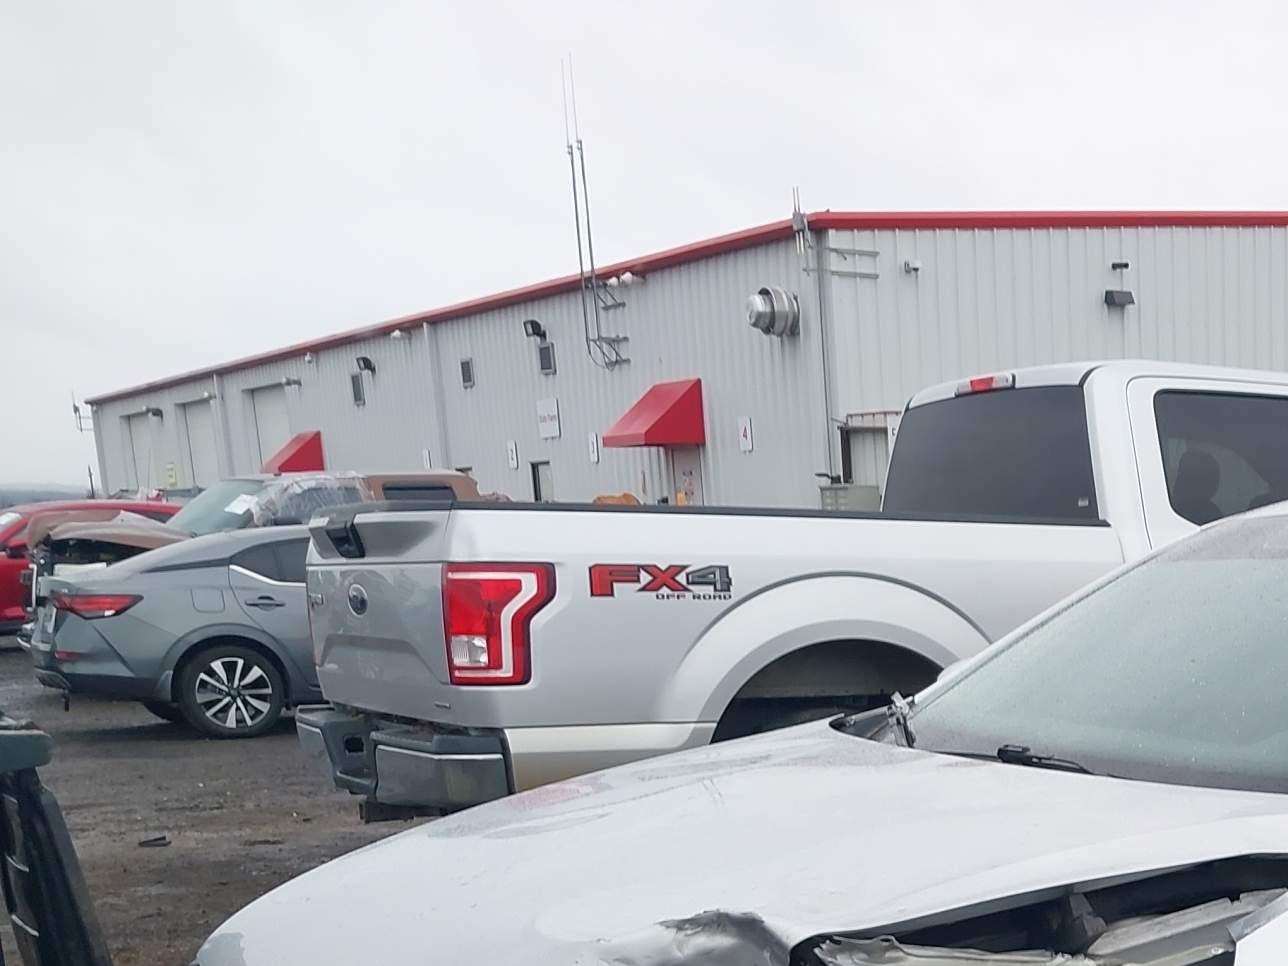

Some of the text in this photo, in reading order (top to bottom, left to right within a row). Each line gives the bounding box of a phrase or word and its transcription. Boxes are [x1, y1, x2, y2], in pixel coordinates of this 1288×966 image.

[588, 563, 732, 597] FX4
[655, 593, 732, 601] OFF ROAD
